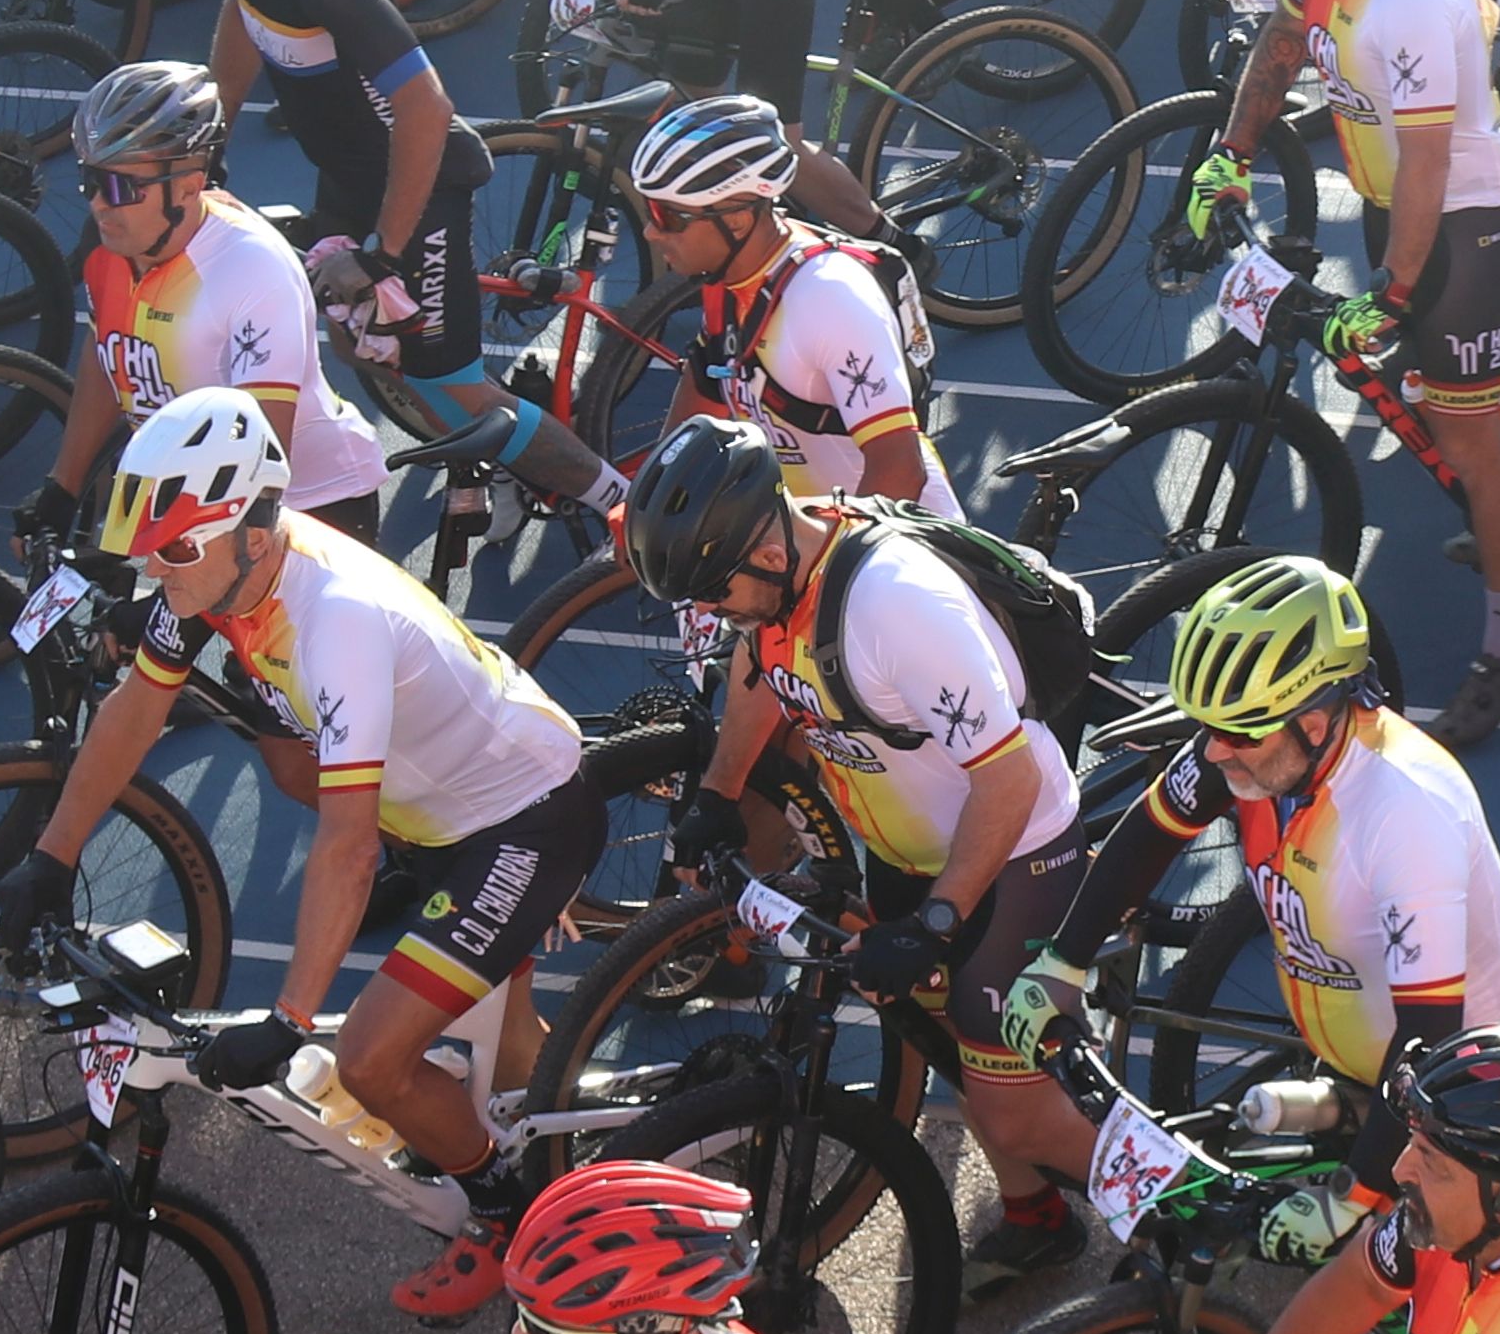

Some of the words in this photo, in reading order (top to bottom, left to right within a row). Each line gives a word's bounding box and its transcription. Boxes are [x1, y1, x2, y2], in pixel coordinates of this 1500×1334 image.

[421, 226, 448, 331] NARIXA
[1274, 656, 1327, 705] SCOTT
[780, 782, 842, 860] MAXXIS
[150, 812, 209, 897] MAXXIS
[450, 912, 501, 958] C.D.
[1171, 906, 1194, 924] DT
